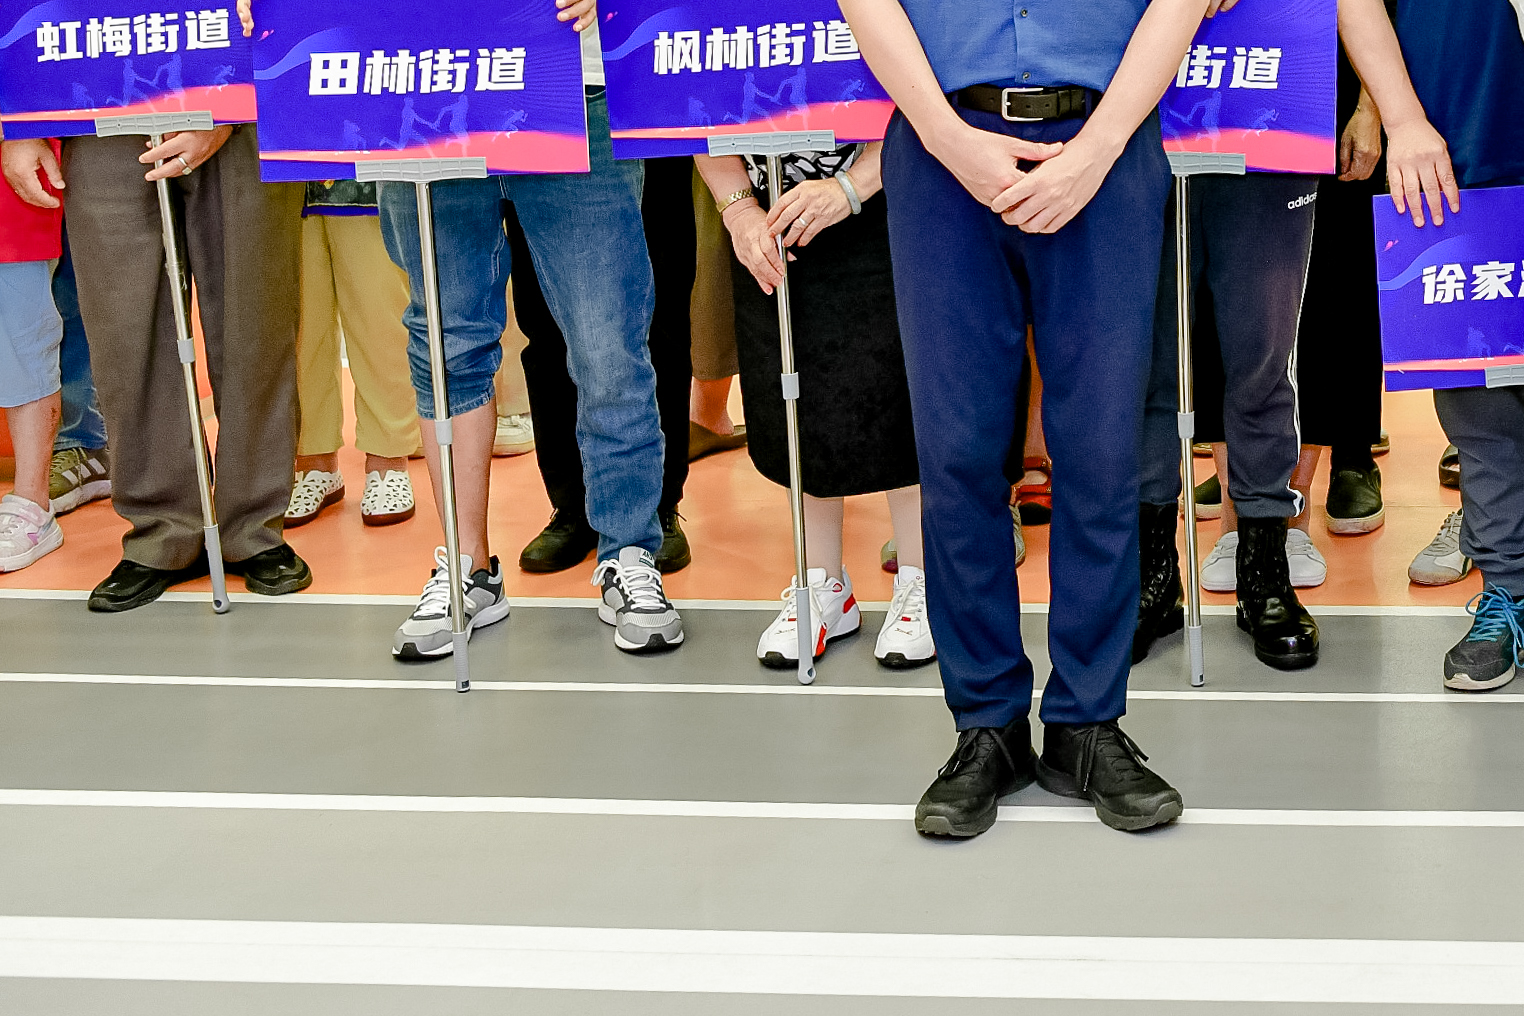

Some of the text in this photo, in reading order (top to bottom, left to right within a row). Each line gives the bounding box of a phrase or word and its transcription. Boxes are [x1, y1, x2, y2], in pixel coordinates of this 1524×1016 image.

[36, 7, 231, 63] 虹梅街道
[653, 19, 861, 75] 枫林街道
[308, 46, 527, 96] 田林街道
[1175, 44, 1283, 90] 街道
